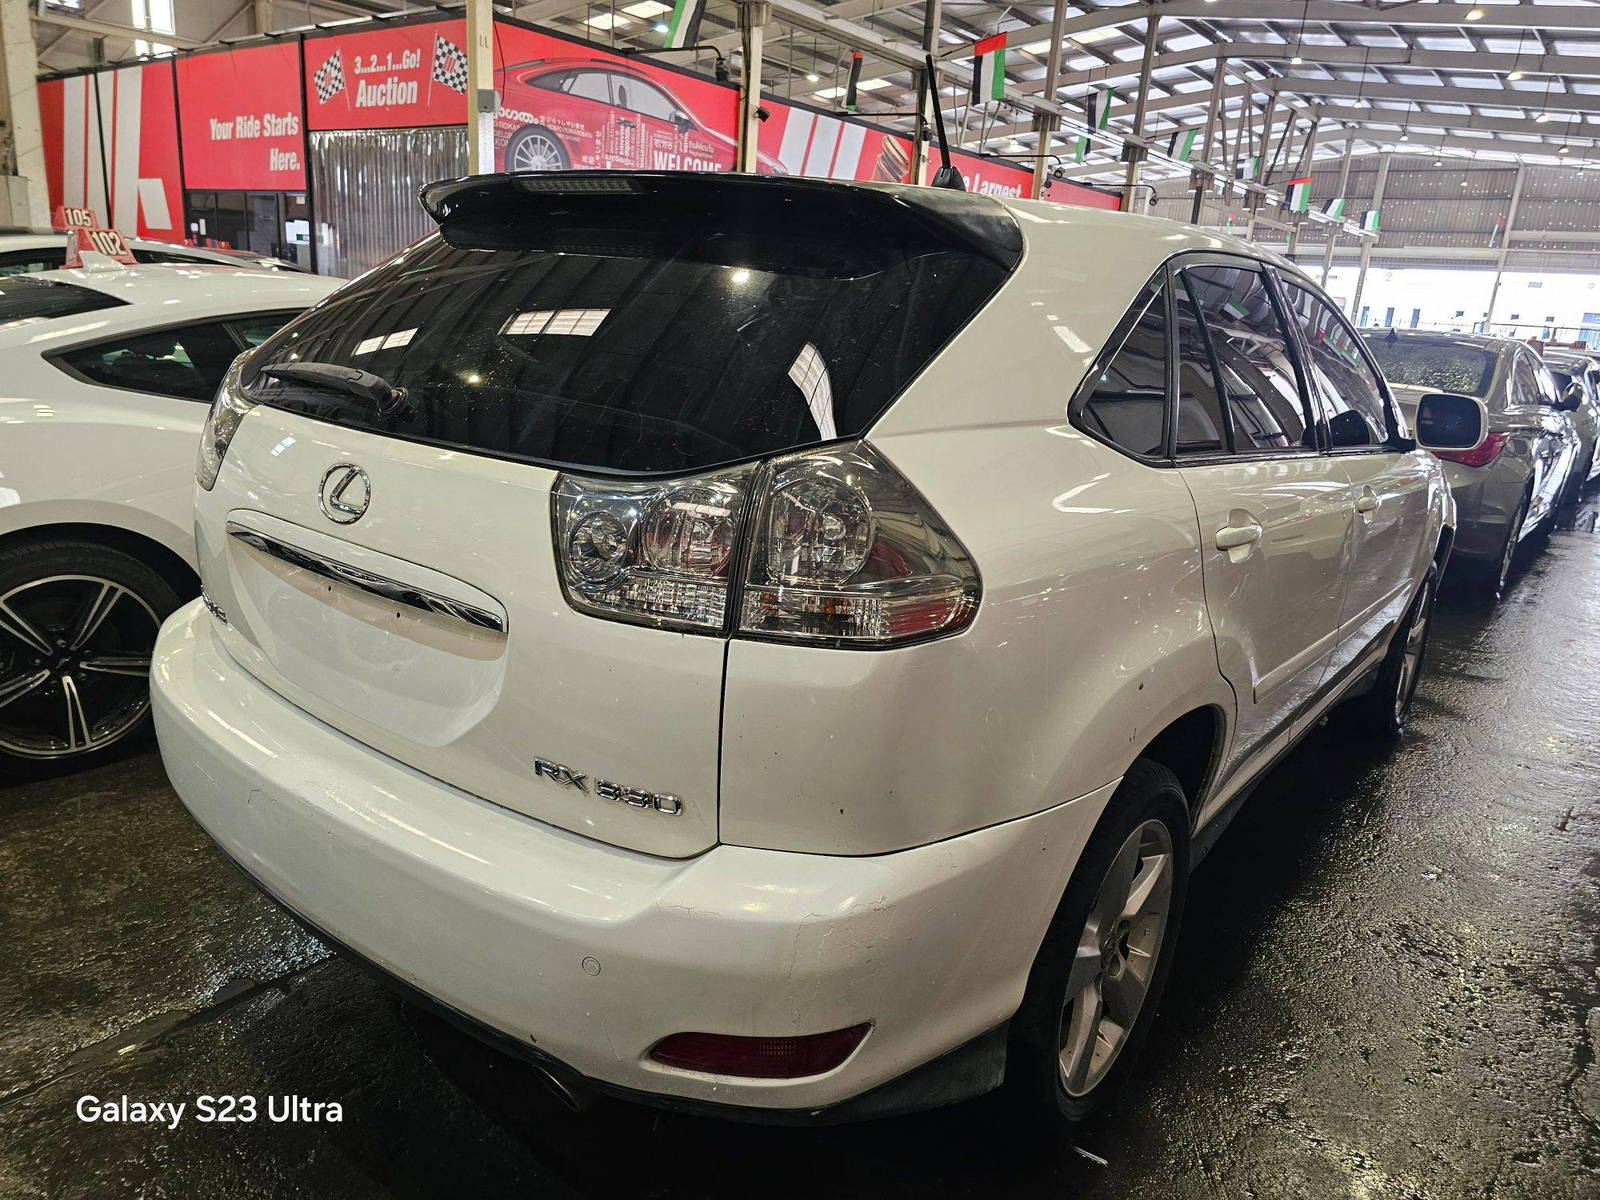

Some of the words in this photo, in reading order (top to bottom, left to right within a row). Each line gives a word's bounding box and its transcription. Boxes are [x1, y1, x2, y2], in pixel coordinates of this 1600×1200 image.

[355, 76, 419, 108] Auction
[209, 117, 234, 141] Your
[235, 114, 261, 139] Ride
[262, 111, 300, 138] Starts
[269, 147, 301, 172] Here.
[65, 207, 92, 228] 105
[91, 230, 129, 257] 102
[534, 756, 590, 796] RX
[594, 777, 684, 817] 330
